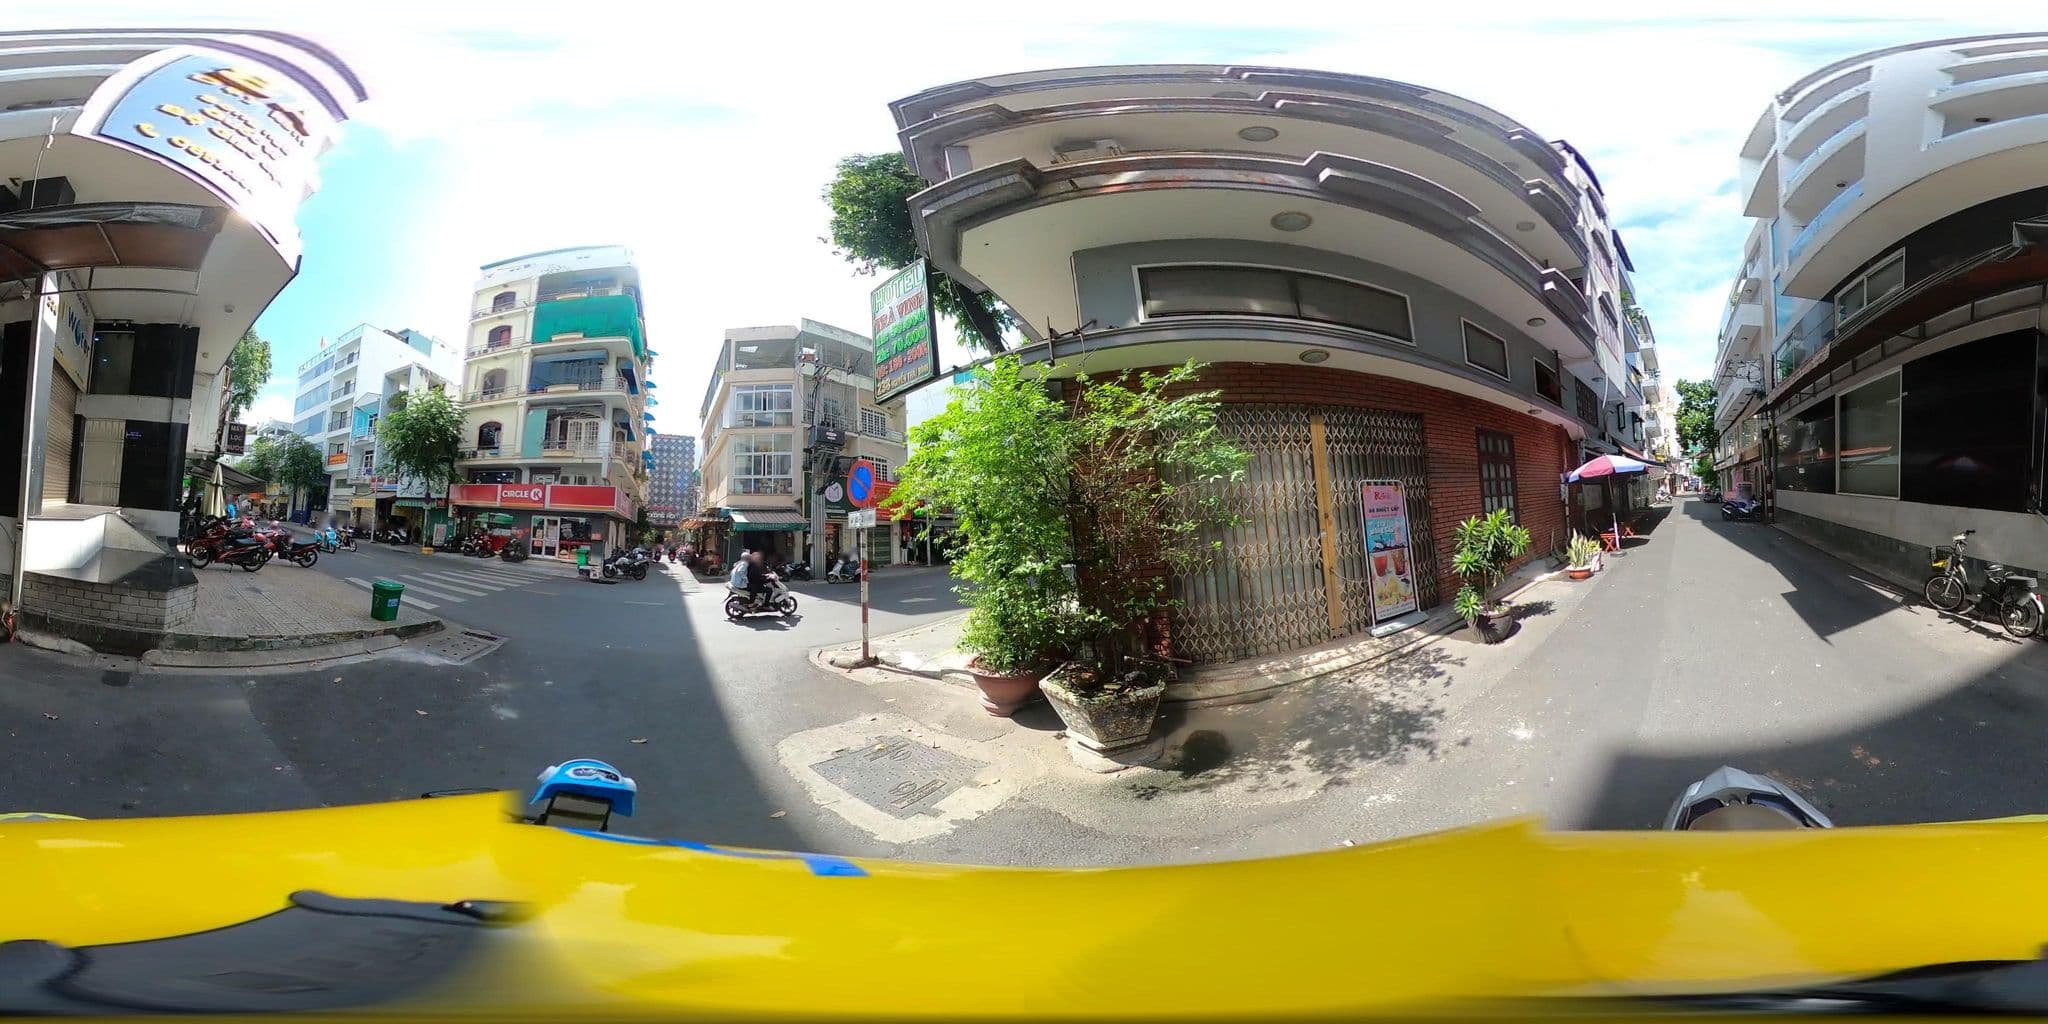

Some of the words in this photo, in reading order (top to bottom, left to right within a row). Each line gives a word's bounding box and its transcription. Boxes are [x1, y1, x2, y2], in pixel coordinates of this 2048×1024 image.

[874, 264, 924, 313] HOTEL
[502, 490, 529, 498] CIRCLE
[530, 488, 543, 501] K
